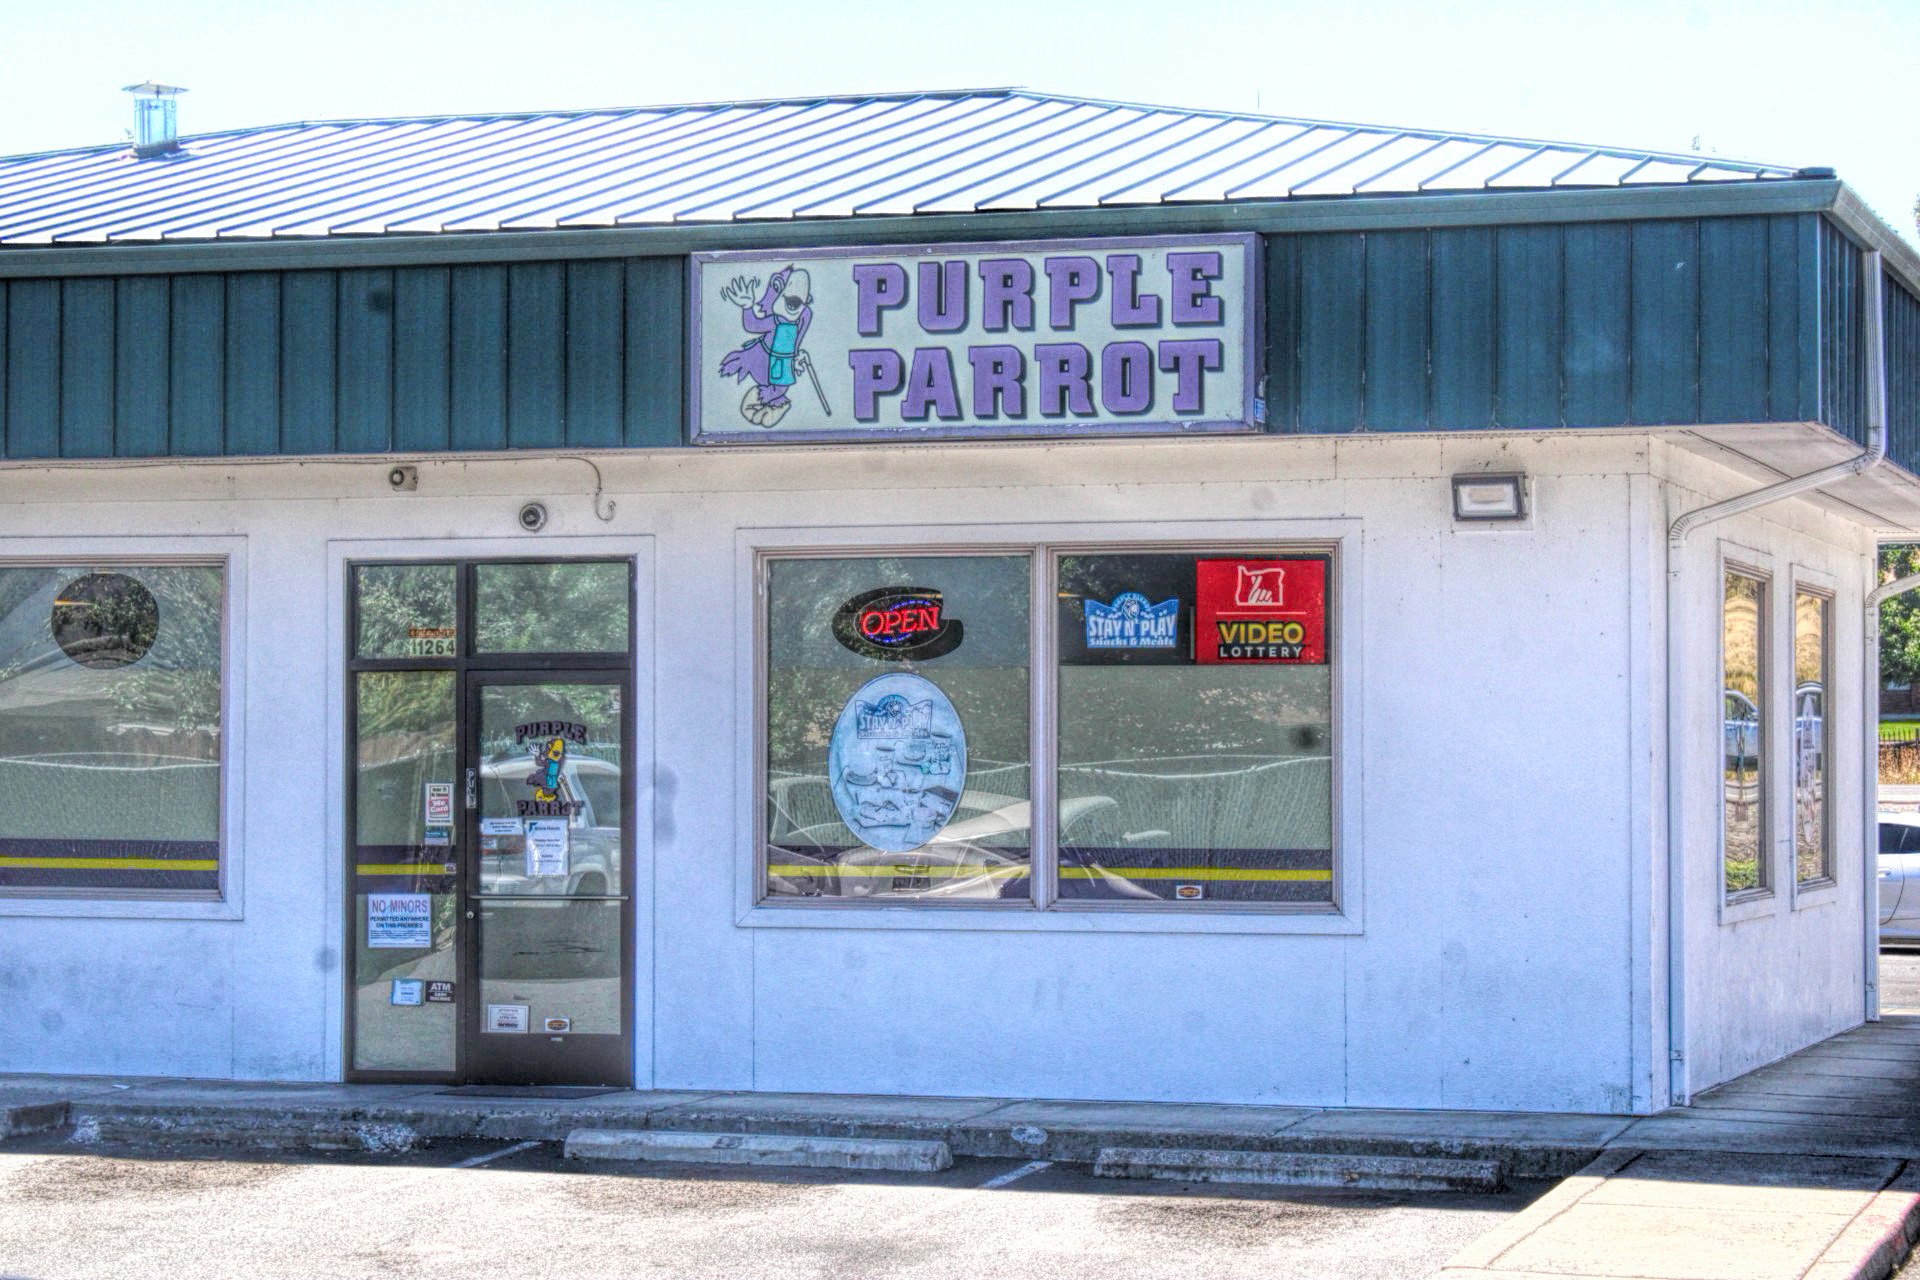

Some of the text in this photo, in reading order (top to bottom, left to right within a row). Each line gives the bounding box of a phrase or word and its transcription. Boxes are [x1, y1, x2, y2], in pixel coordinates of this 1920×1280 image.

[853, 252, 1225, 336] PURPLE
[848, 338, 1222, 422] PARROT
[861, 607, 939, 634] OPEN
[1089, 614, 1122, 638] STAY
[1140, 613, 1175, 638] PLAY
[1218, 621, 1304, 645] VIDEO
[410, 639, 455, 656] 11264
[1220, 646, 1303, 658] LOTTERY
[516, 721, 587, 745] PURPLE
[516, 801, 585, 816] PARROT
[371, 899, 428, 913] NO MINORS
[430, 982, 452, 991] ATM
